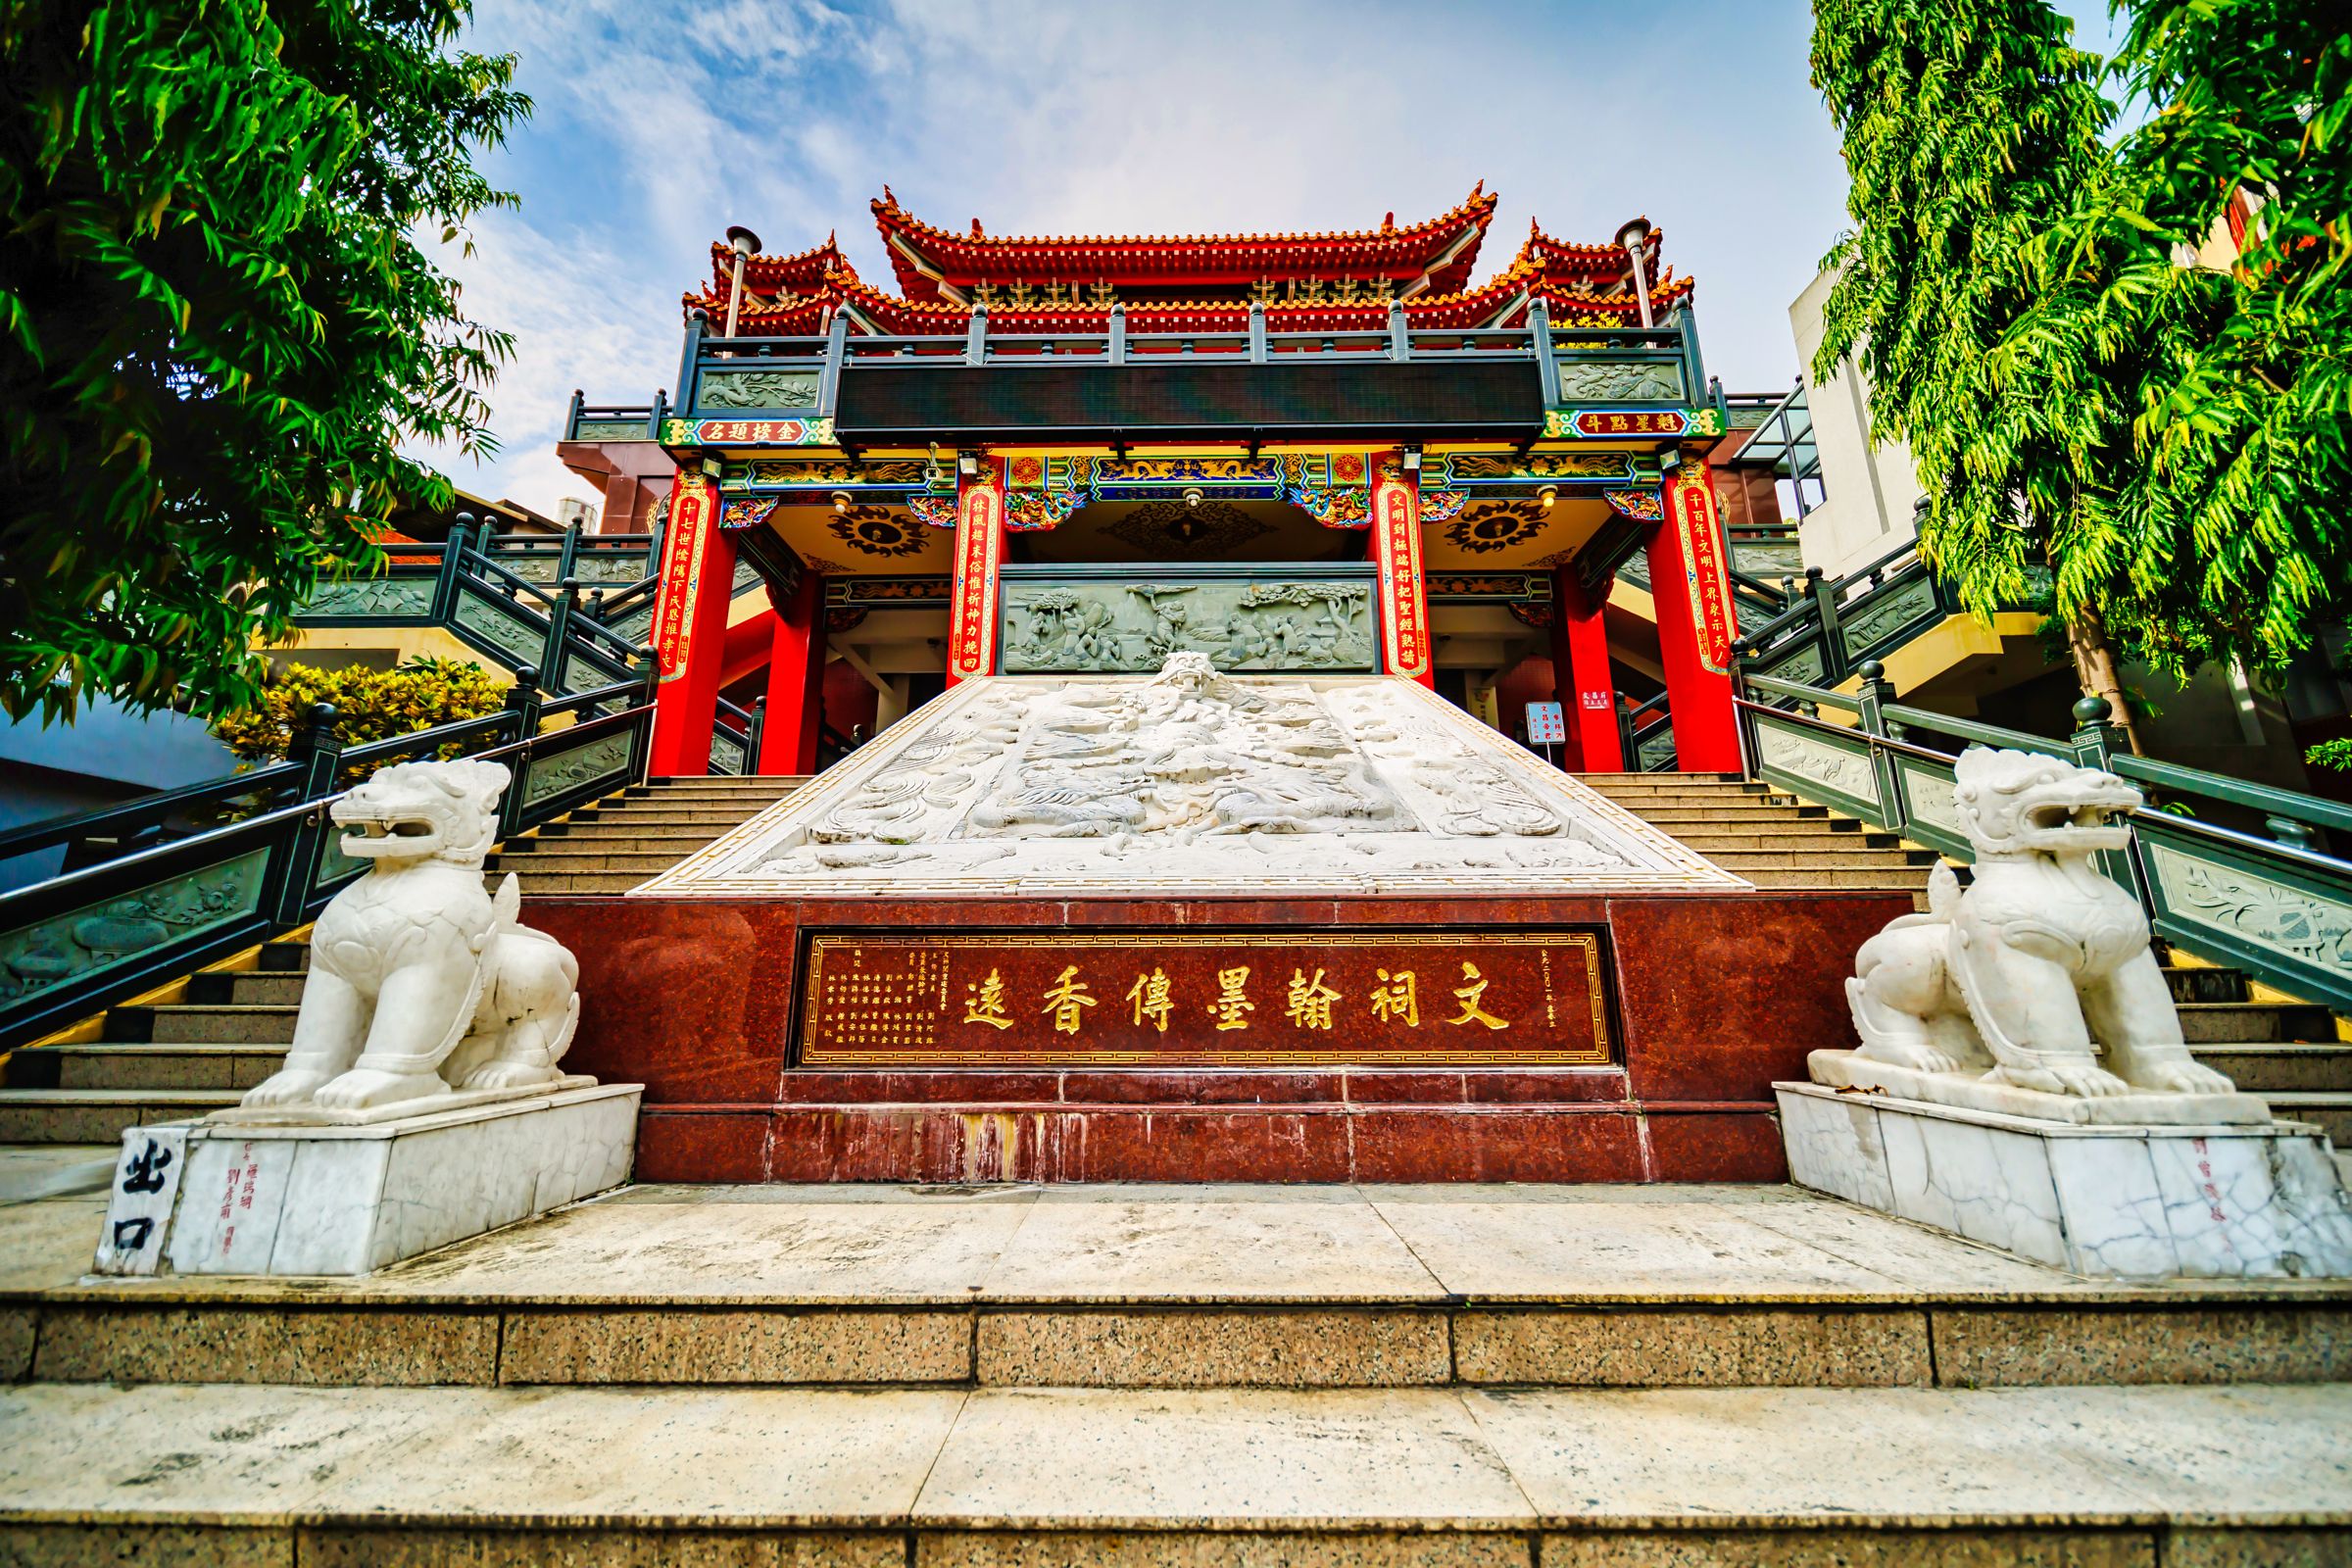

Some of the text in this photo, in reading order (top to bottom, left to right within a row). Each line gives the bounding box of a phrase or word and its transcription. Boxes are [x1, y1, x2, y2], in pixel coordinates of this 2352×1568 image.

[1392, 494, 1415, 664] 文明到極端好把聖經熟讀
[115, 1138, 172, 1250] 出口
